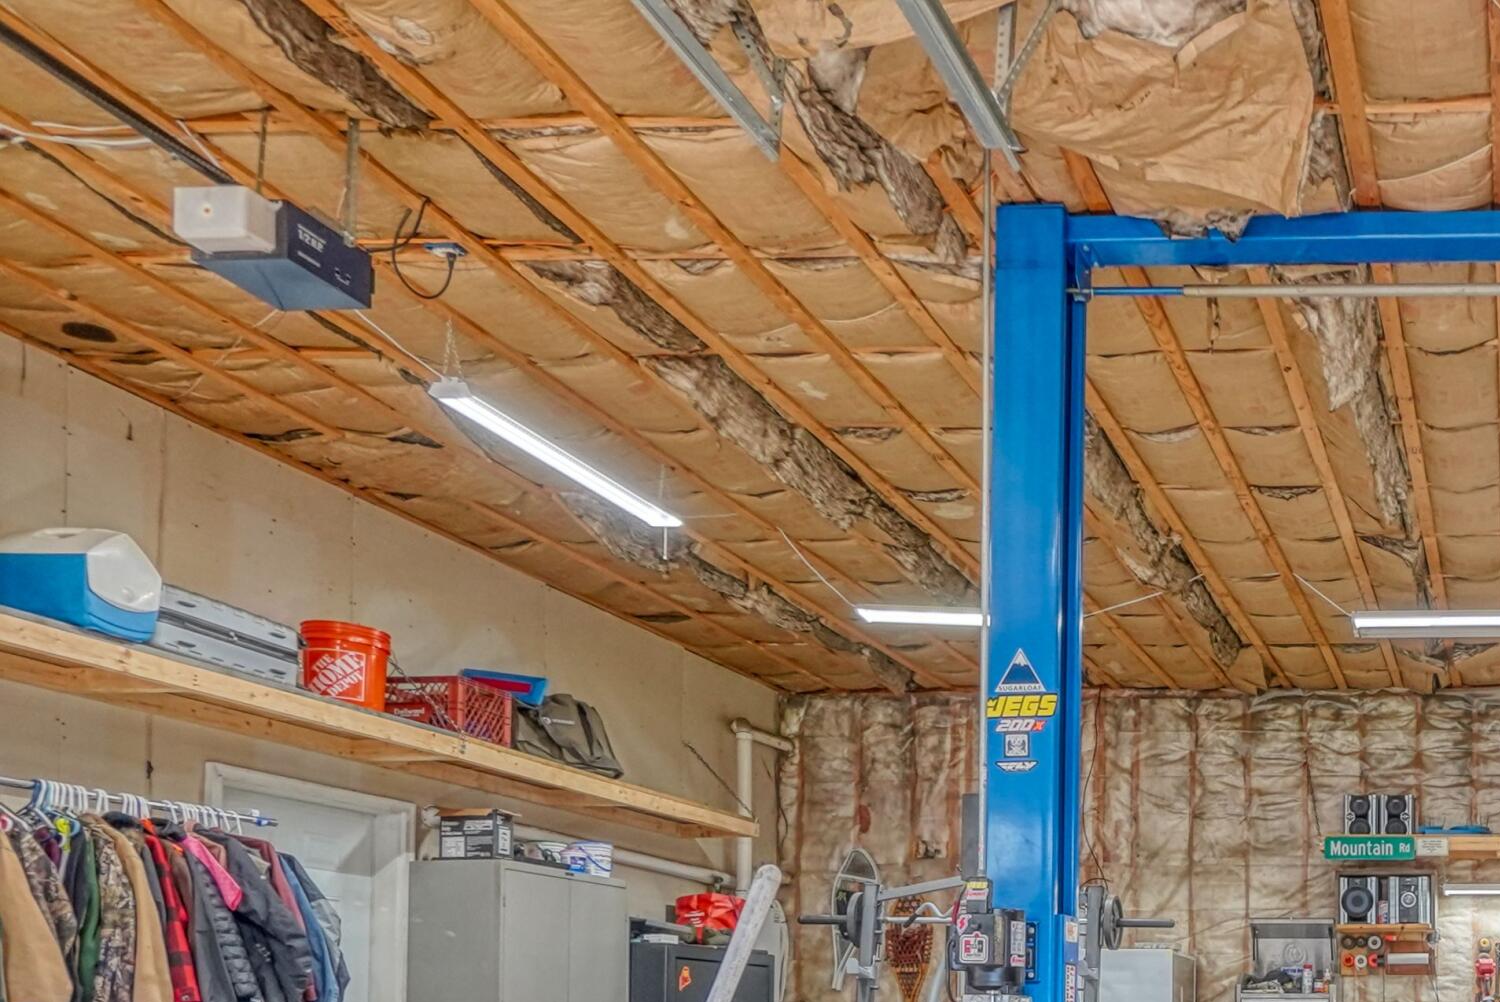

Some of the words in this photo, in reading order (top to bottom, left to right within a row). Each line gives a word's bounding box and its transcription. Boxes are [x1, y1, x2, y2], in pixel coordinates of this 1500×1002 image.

[310, 652, 364, 694] HOME
[312, 654, 335, 673] THE
[327, 672, 364, 698] DEPOT
[998, 684, 1042, 692] SUGARLOAF
[986, 694, 1058, 718] JEGS
[1329, 840, 1394, 856] Mountain
[1399, 843, 1411, 853] Rd
